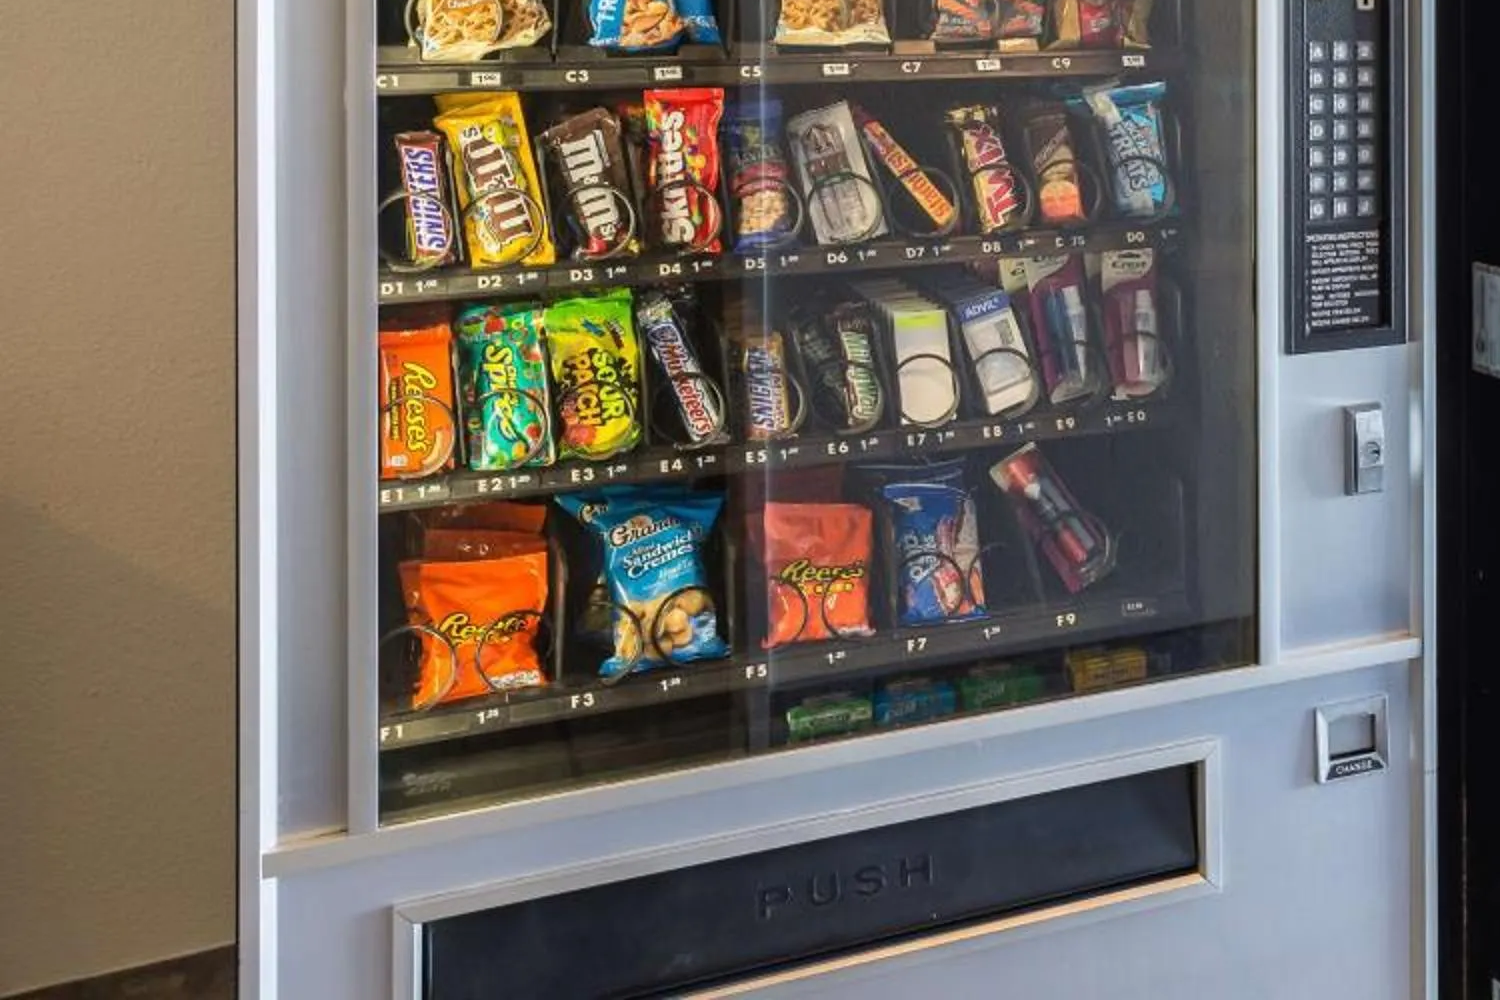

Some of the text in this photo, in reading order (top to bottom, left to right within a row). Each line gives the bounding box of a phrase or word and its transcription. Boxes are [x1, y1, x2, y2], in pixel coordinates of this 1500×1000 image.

[902, 61, 921, 73] C7
[1052, 58, 1071, 69] C9
[566, 70, 588, 83] C3
[741, 65, 761, 78] C5
[377, 75, 399, 88] C1
[659, 110, 696, 245] Skittles
[402, 146, 448, 250] SNICKERS
[906, 246, 925, 259] D7
[982, 241, 1001, 253] D8
[745, 258, 766, 270] D5
[827, 252, 848, 264] D6
[1110, 259, 1149, 271] Crest
[570, 269, 593, 282] D3
[660, 262, 681, 275] D4
[381, 282, 403, 295] D1
[477, 275, 501, 289] D2
[964, 297, 998, 319] ADVIL
[576, 352, 601, 426] PATCH
[592, 349, 627, 420] SOUR
[662, 344, 713, 436] Musketeers
[403, 361, 438, 451] Reese's
[983, 425, 1001, 438] E8
[1056, 418, 1075, 431] E9
[907, 432, 927, 446] E7
[828, 442, 848, 455] E6
[745, 450, 767, 463] E5
[660, 459, 682, 472] E4
[571, 469, 593, 483] E3
[478, 479, 502, 493] E2
[381, 489, 404, 503] E1
[1056, 612, 1075, 627] F9
[907, 637, 927, 653] F7
[746, 664, 767, 679] F5
[571, 694, 594, 709] F3
[380, 726, 403, 741] F1
[1335, 757, 1375, 777] CHANGE
[757, 854, 934, 921] PUSH
